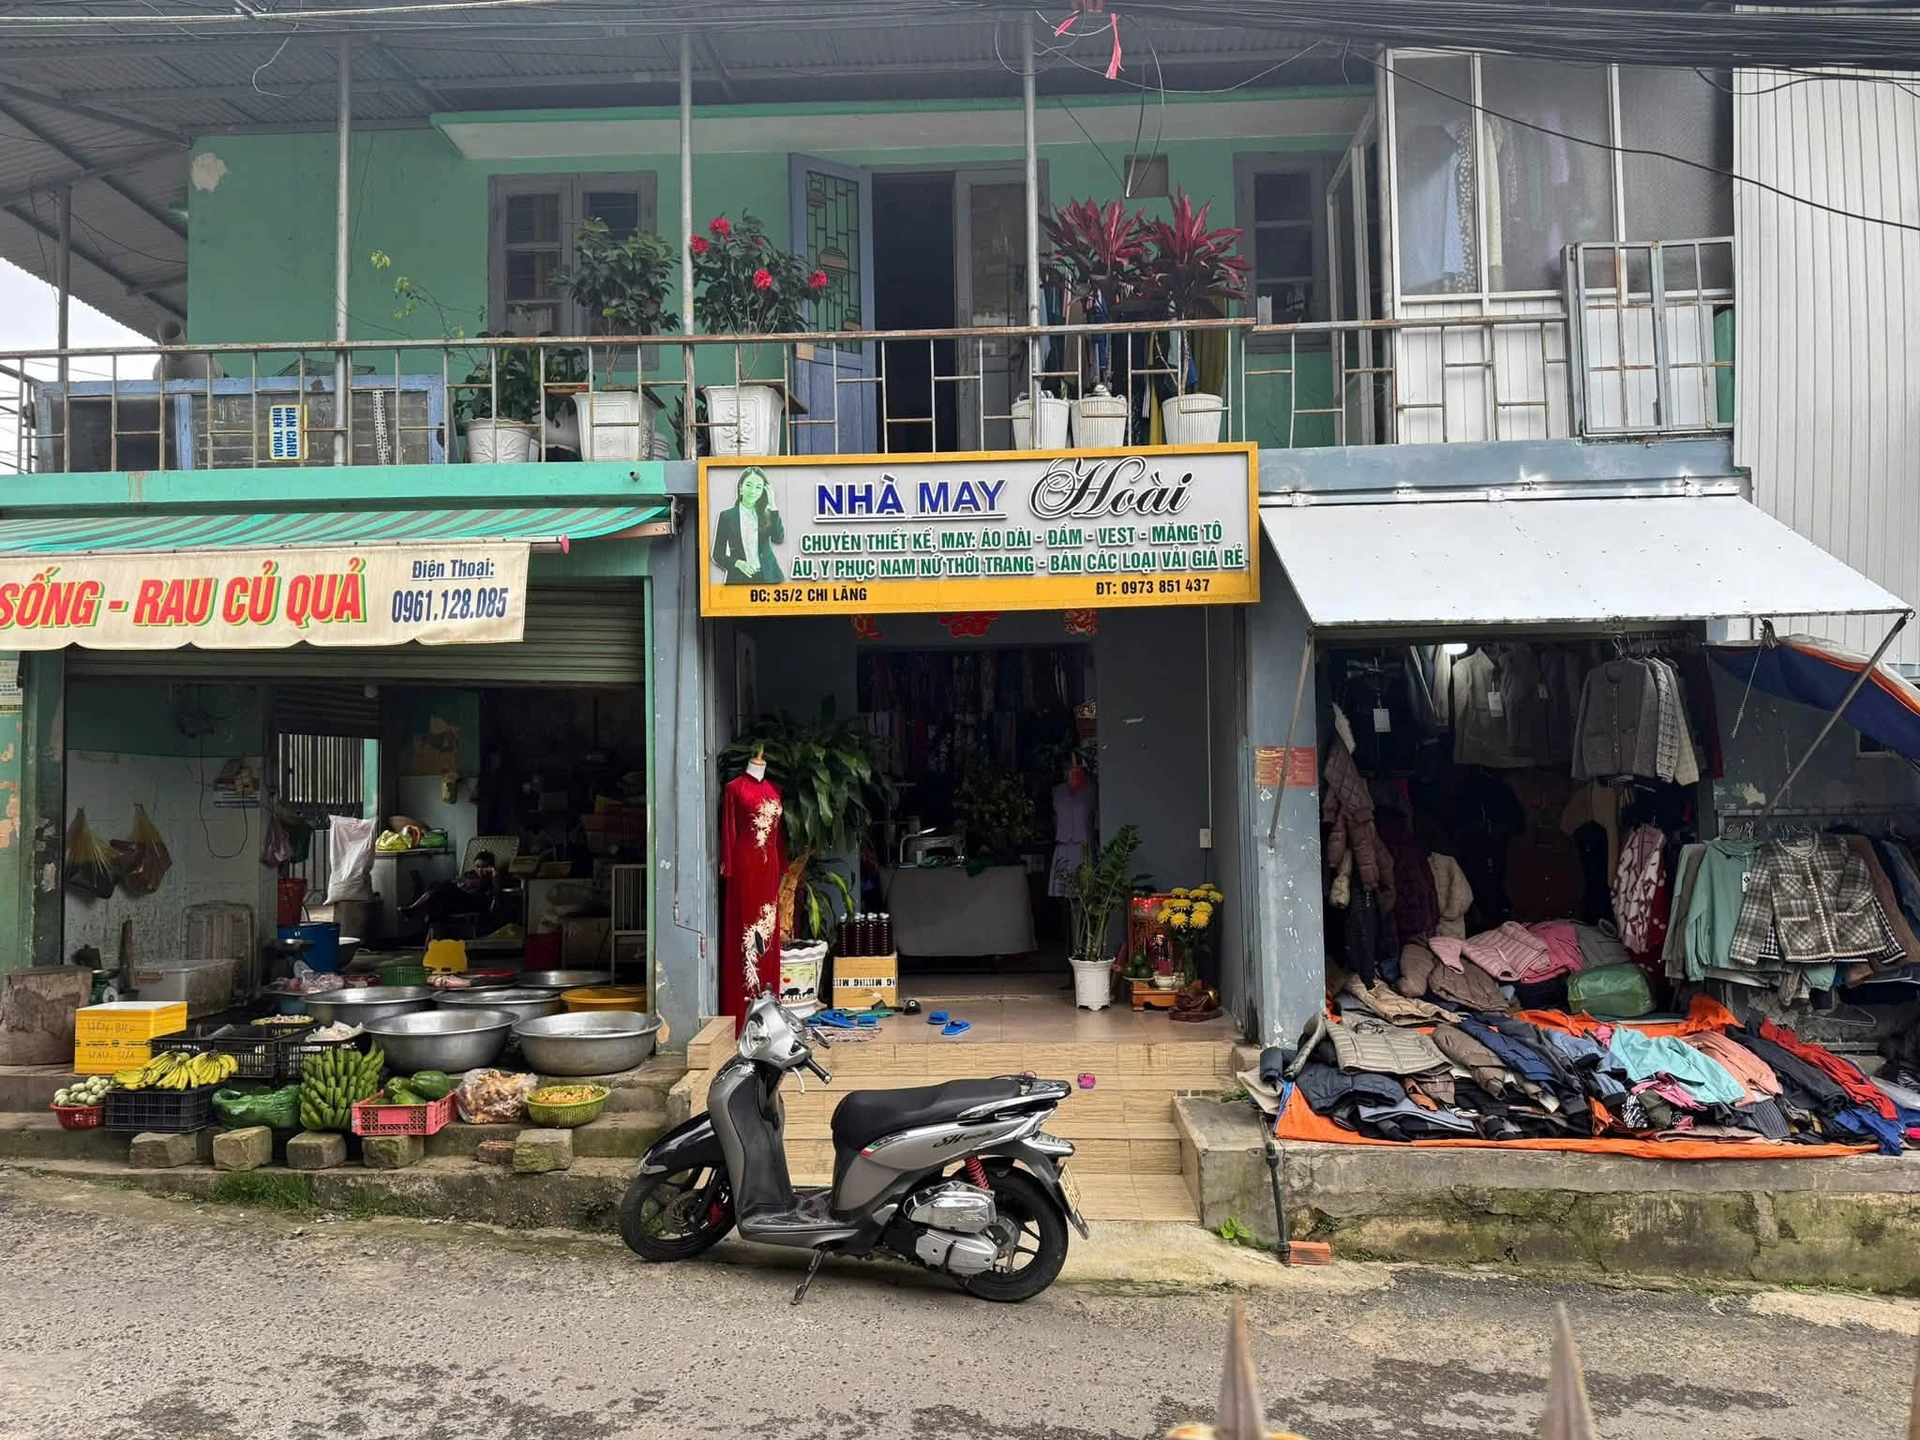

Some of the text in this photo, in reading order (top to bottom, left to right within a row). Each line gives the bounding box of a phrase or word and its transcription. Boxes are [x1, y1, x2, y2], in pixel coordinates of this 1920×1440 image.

[285, 430, 298, 458] CARD
[815, 457, 1194, 519] NHÀ MAY Hoài
[867, 527, 908, 551] THIẾT
[912, 526, 938, 552] KẾ,
[941, 530, 976, 550] MAY:
[981, 527, 1002, 548] ÁO
[1006, 525, 1032, 547] DÀI
[1098, 526, 1136, 545] VEST
[1151, 521, 1199, 543] MĂNG
[1203, 519, 1223, 541] TÔ
[412, 557, 496, 582] Điện Thoại:
[792, 556, 818, 578] ÂU,
[820, 559, 830, 577] Y
[834, 558, 876, 581] PHỤC
[880, 557, 916, 576] NAM
[920, 553, 944, 575] NỮ
[946, 552, 980, 574] THỜI
[984, 554, 1035, 573] TRANG
[1049, 550, 1083, 572] BÁN
[1086, 549, 1118, 571] CÁC
[1122, 551, 1157, 573] LOẠI
[1161, 545, 1187, 568] VẢI
[1191, 546, 1218, 568] GIÁ
[1223, 544, 1244, 566] RẺ
[0, 557, 369, 629] SỐNG - RAU CỦ QUẢ
[750, 585, 868, 602] ĐC: 35/2 CHI LĂNG
[1095, 578, 1211, 595] ĐT: 0973 851 437
[391, 586, 510, 624] 0961.128.085
[932, 1132, 966, 1148] SH
